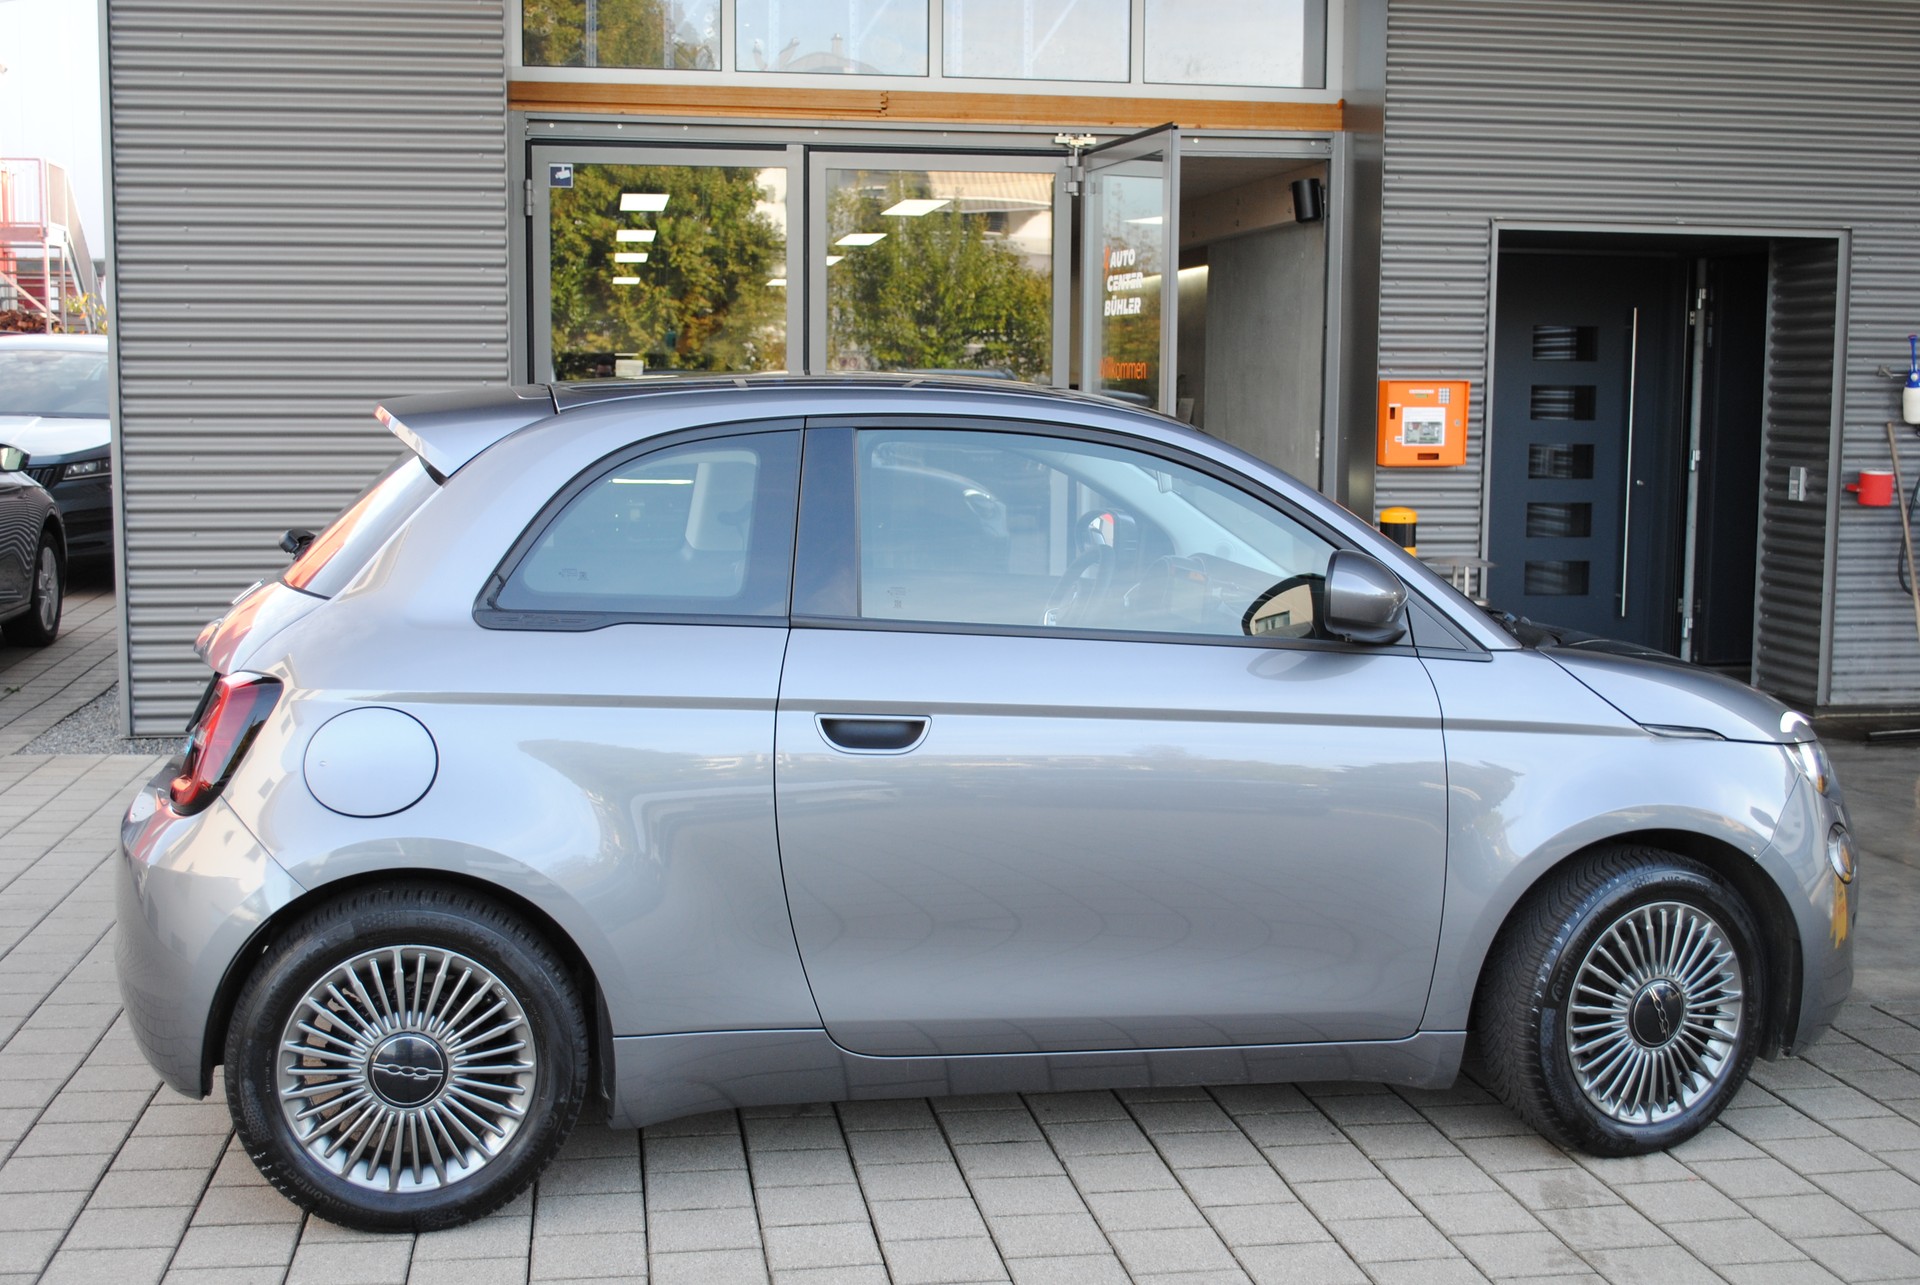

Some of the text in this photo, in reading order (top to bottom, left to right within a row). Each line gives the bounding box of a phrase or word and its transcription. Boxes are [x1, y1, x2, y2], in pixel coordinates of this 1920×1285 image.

[1110, 249, 1136, 268] AUTO
[1107, 272, 1143, 292] CENTER
[1104, 295, 1141, 316] BÜHLER
